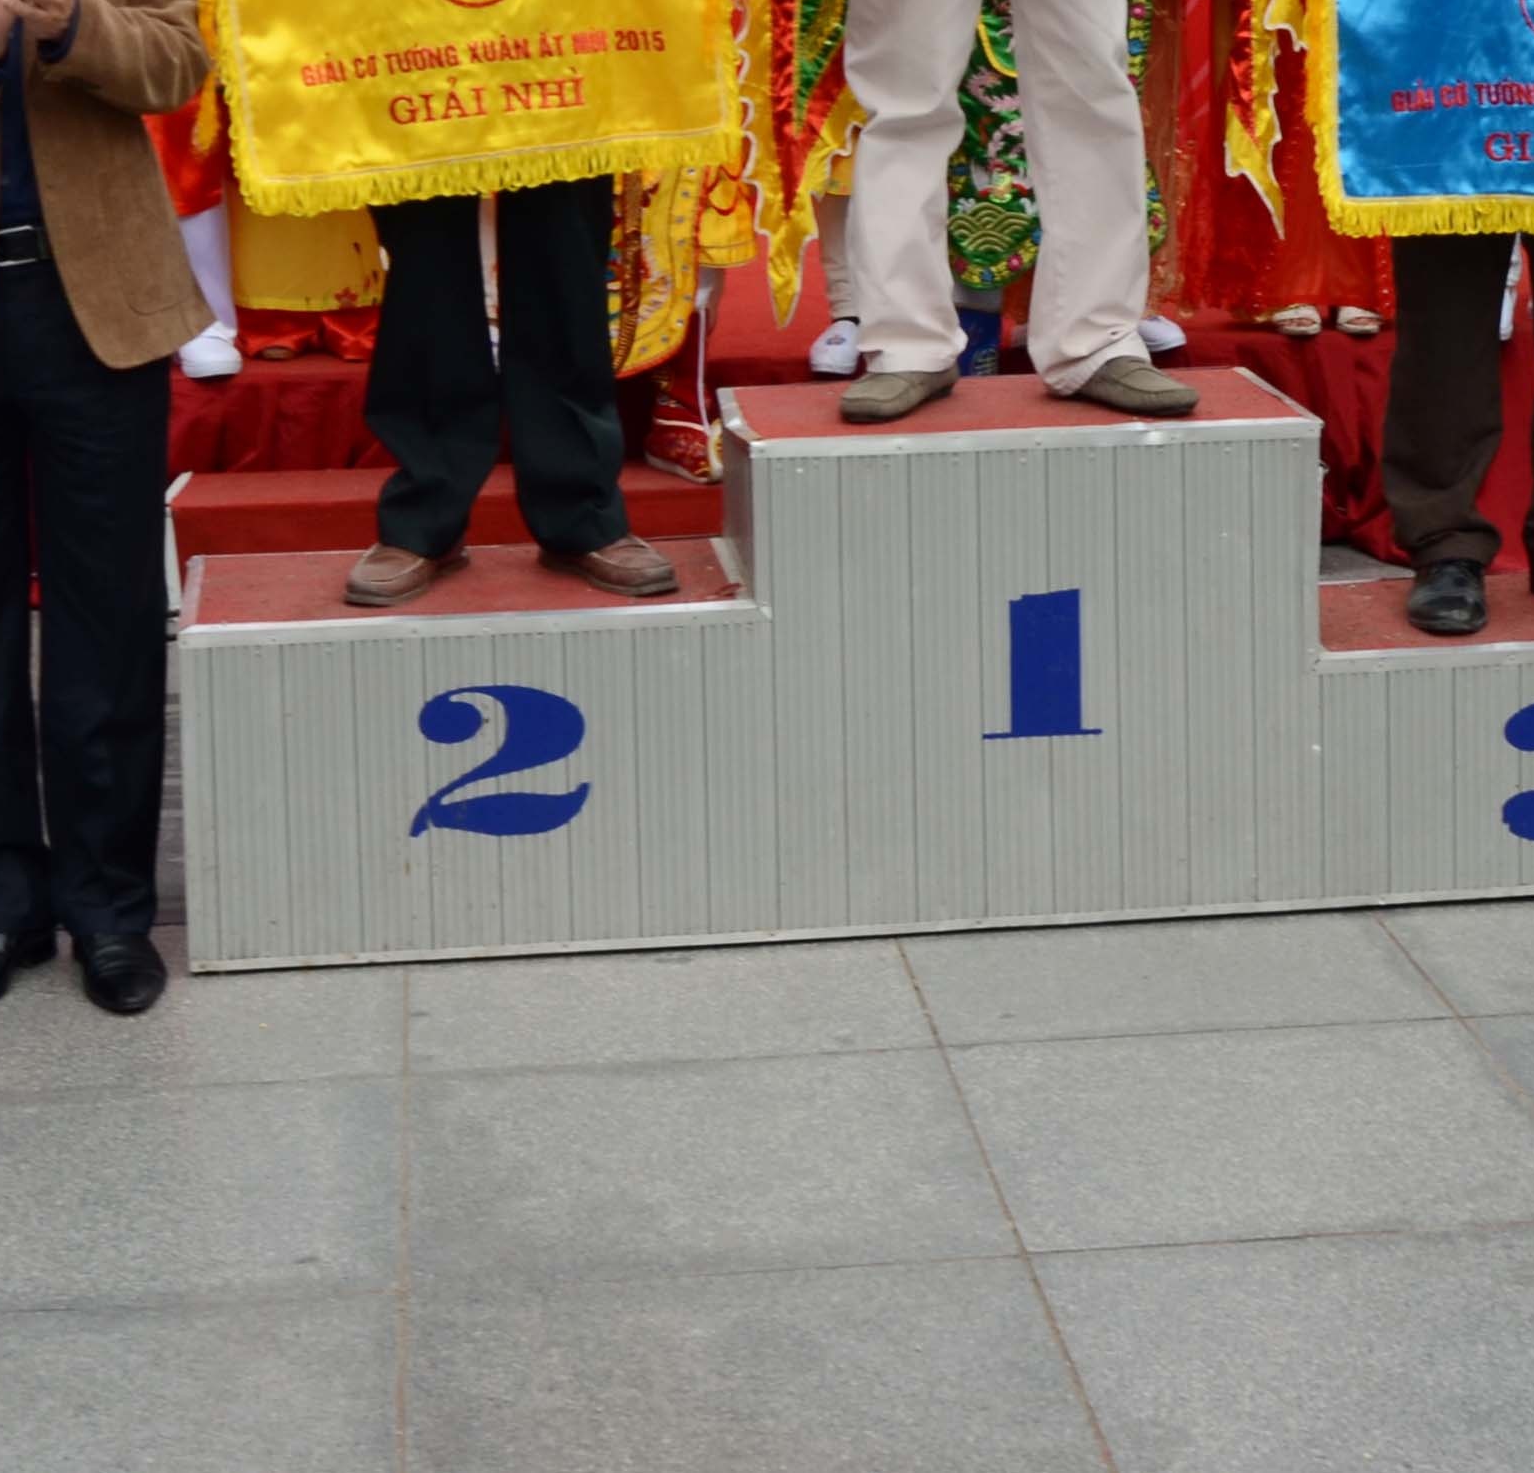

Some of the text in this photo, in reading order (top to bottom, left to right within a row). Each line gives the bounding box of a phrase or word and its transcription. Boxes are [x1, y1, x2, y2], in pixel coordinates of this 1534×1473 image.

[614, 29, 665, 53] 2015
[389, 66, 585, 126] GIẢI NHÌ
[982, 588, 1103, 740] 1
[409, 684, 591, 838] 2
